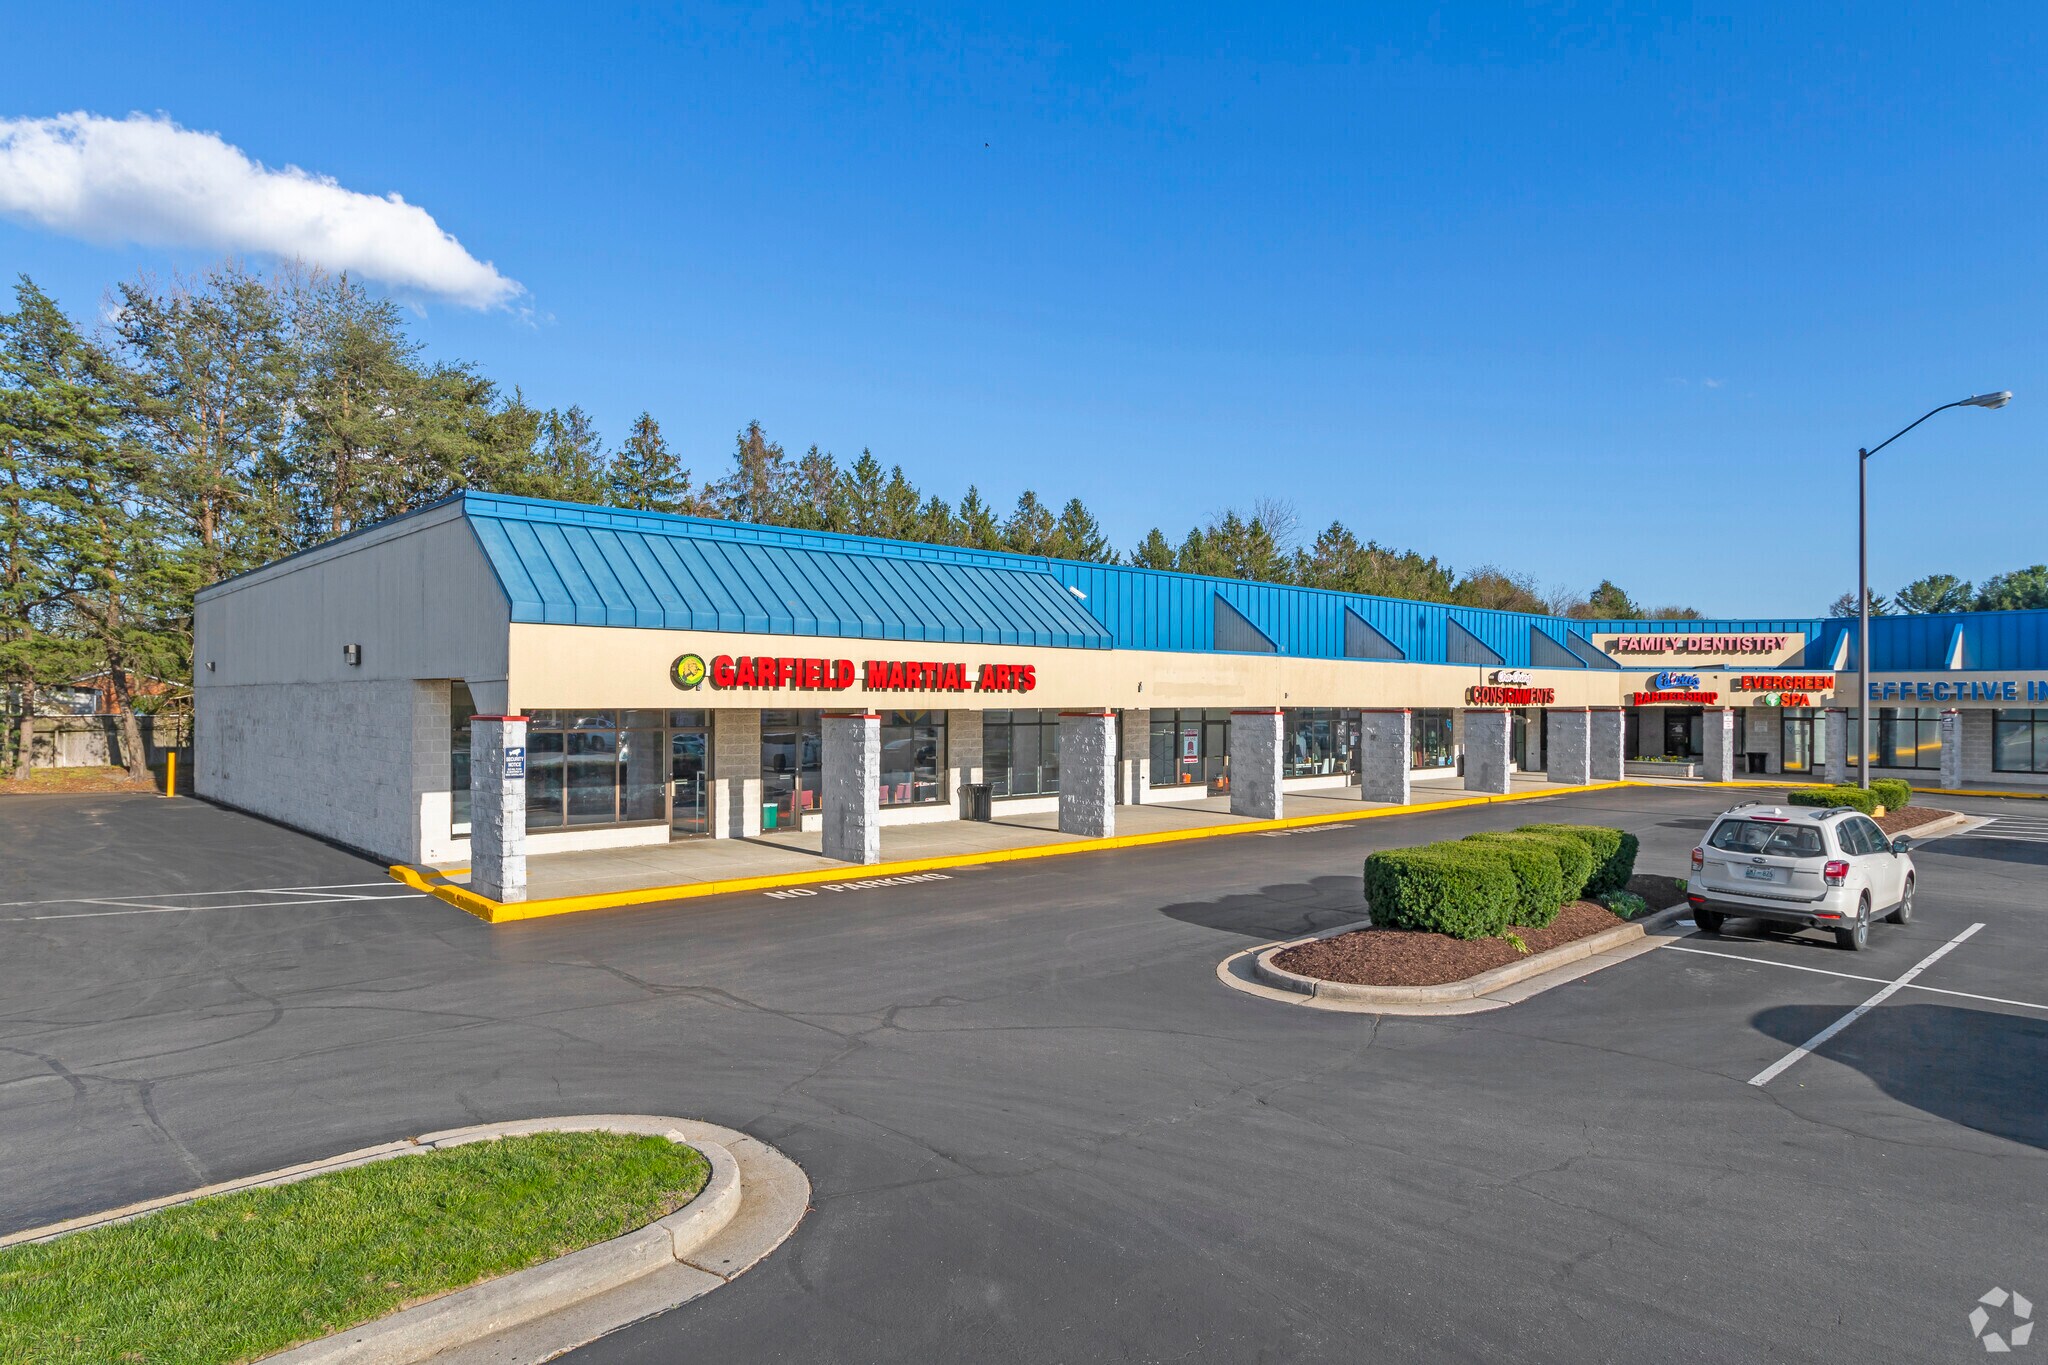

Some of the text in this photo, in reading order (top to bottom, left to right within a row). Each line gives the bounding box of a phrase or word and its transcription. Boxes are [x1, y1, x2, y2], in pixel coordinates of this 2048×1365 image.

[1618, 637, 1788, 651] FAMILY DENTISTRY
[714, 655, 855, 688] GARFIELD
[867, 660, 971, 690] MARTIAL
[981, 665, 1037, 691] ARTS
[1741, 675, 1834, 690] EVERGREEN
[1868, 681, 2018, 701] EFFECTIVE
[1473, 686, 1555, 705] CONSIGNMENTS
[1633, 692, 1718, 706] BARBERSHOP
[1780, 693, 1810, 707] SPA
[763, 873, 954, 900] NO PARKING
